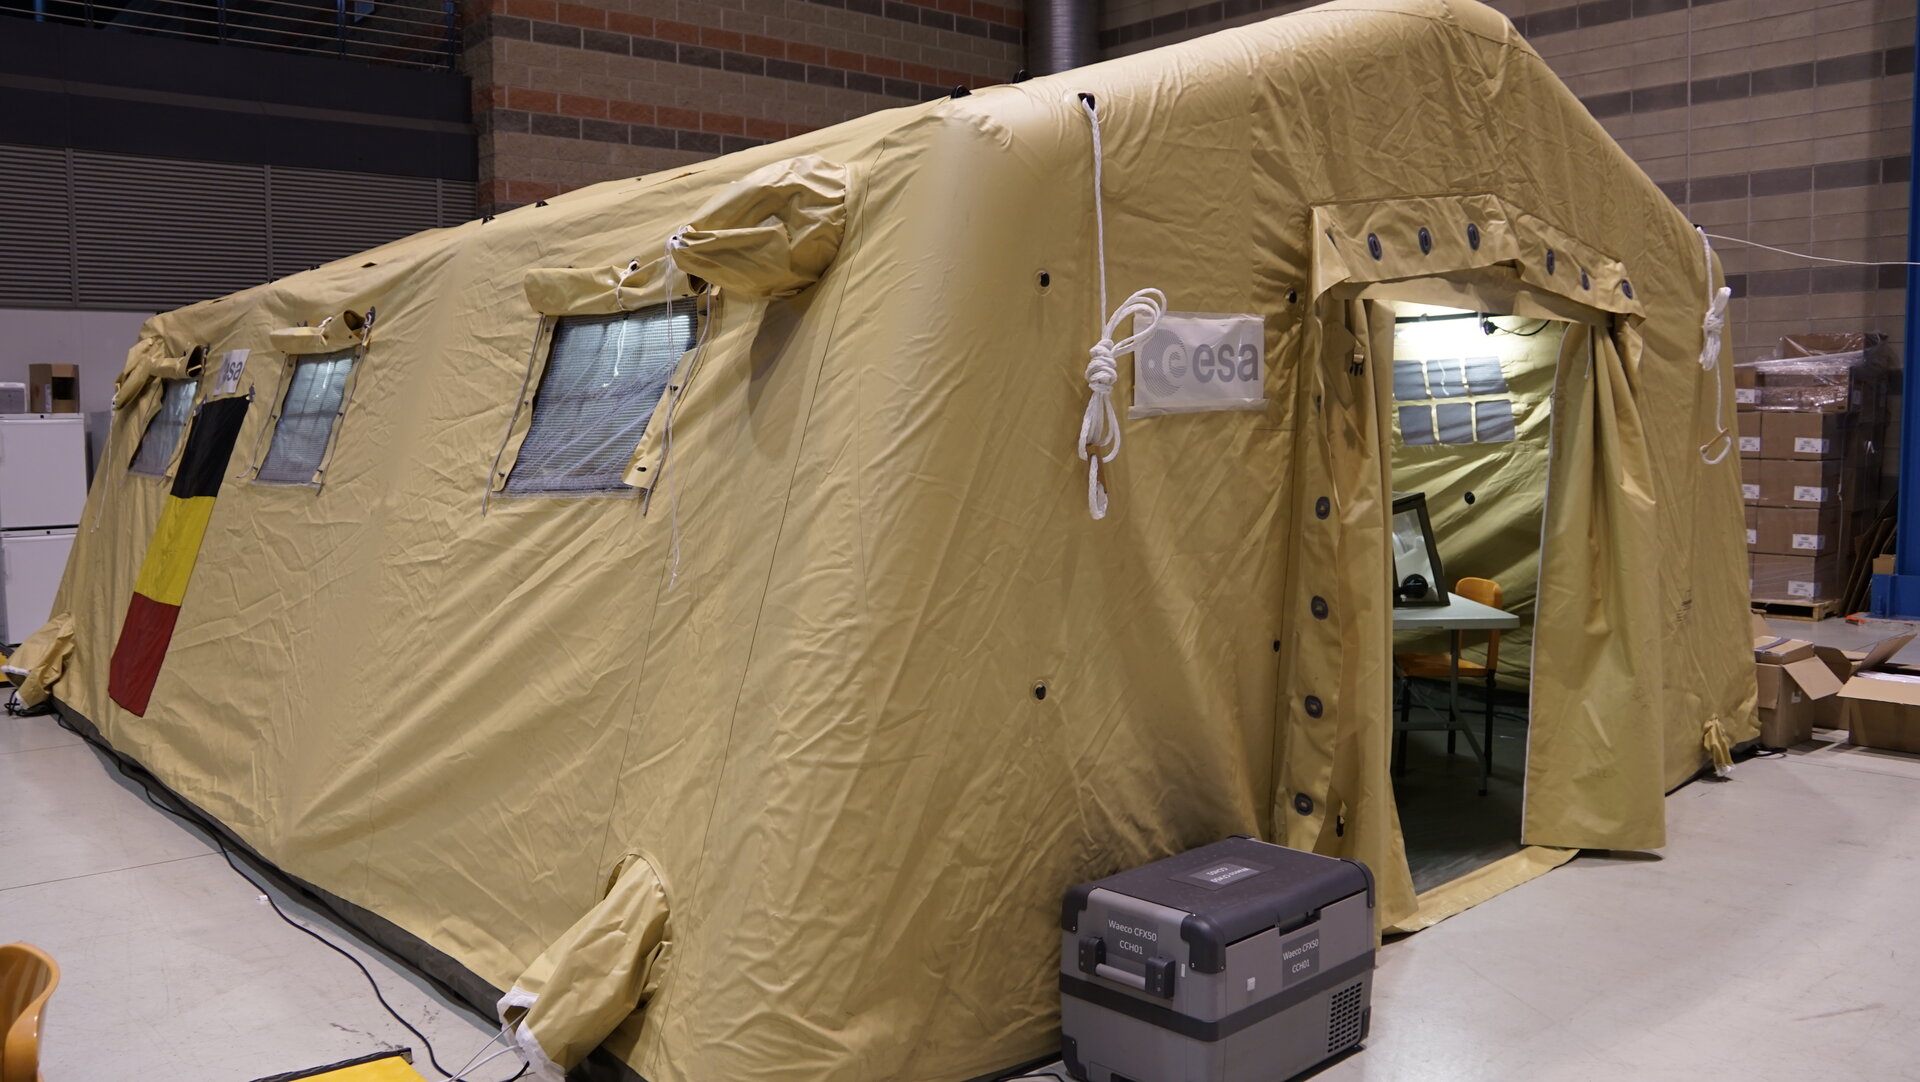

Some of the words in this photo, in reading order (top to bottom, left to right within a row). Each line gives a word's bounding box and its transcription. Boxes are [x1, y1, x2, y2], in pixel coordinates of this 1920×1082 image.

[1192, 343, 1259, 384] esa
[1108, 919, 1133, 934] Waeco
[1134, 927, 1157, 942] CFX50
[1119, 940, 1143, 955] CCH01
[1282, 947, 1301, 961] Waeco
[1302, 938, 1319, 952] CFX50
[1291, 959, 1310, 973] CCH01
